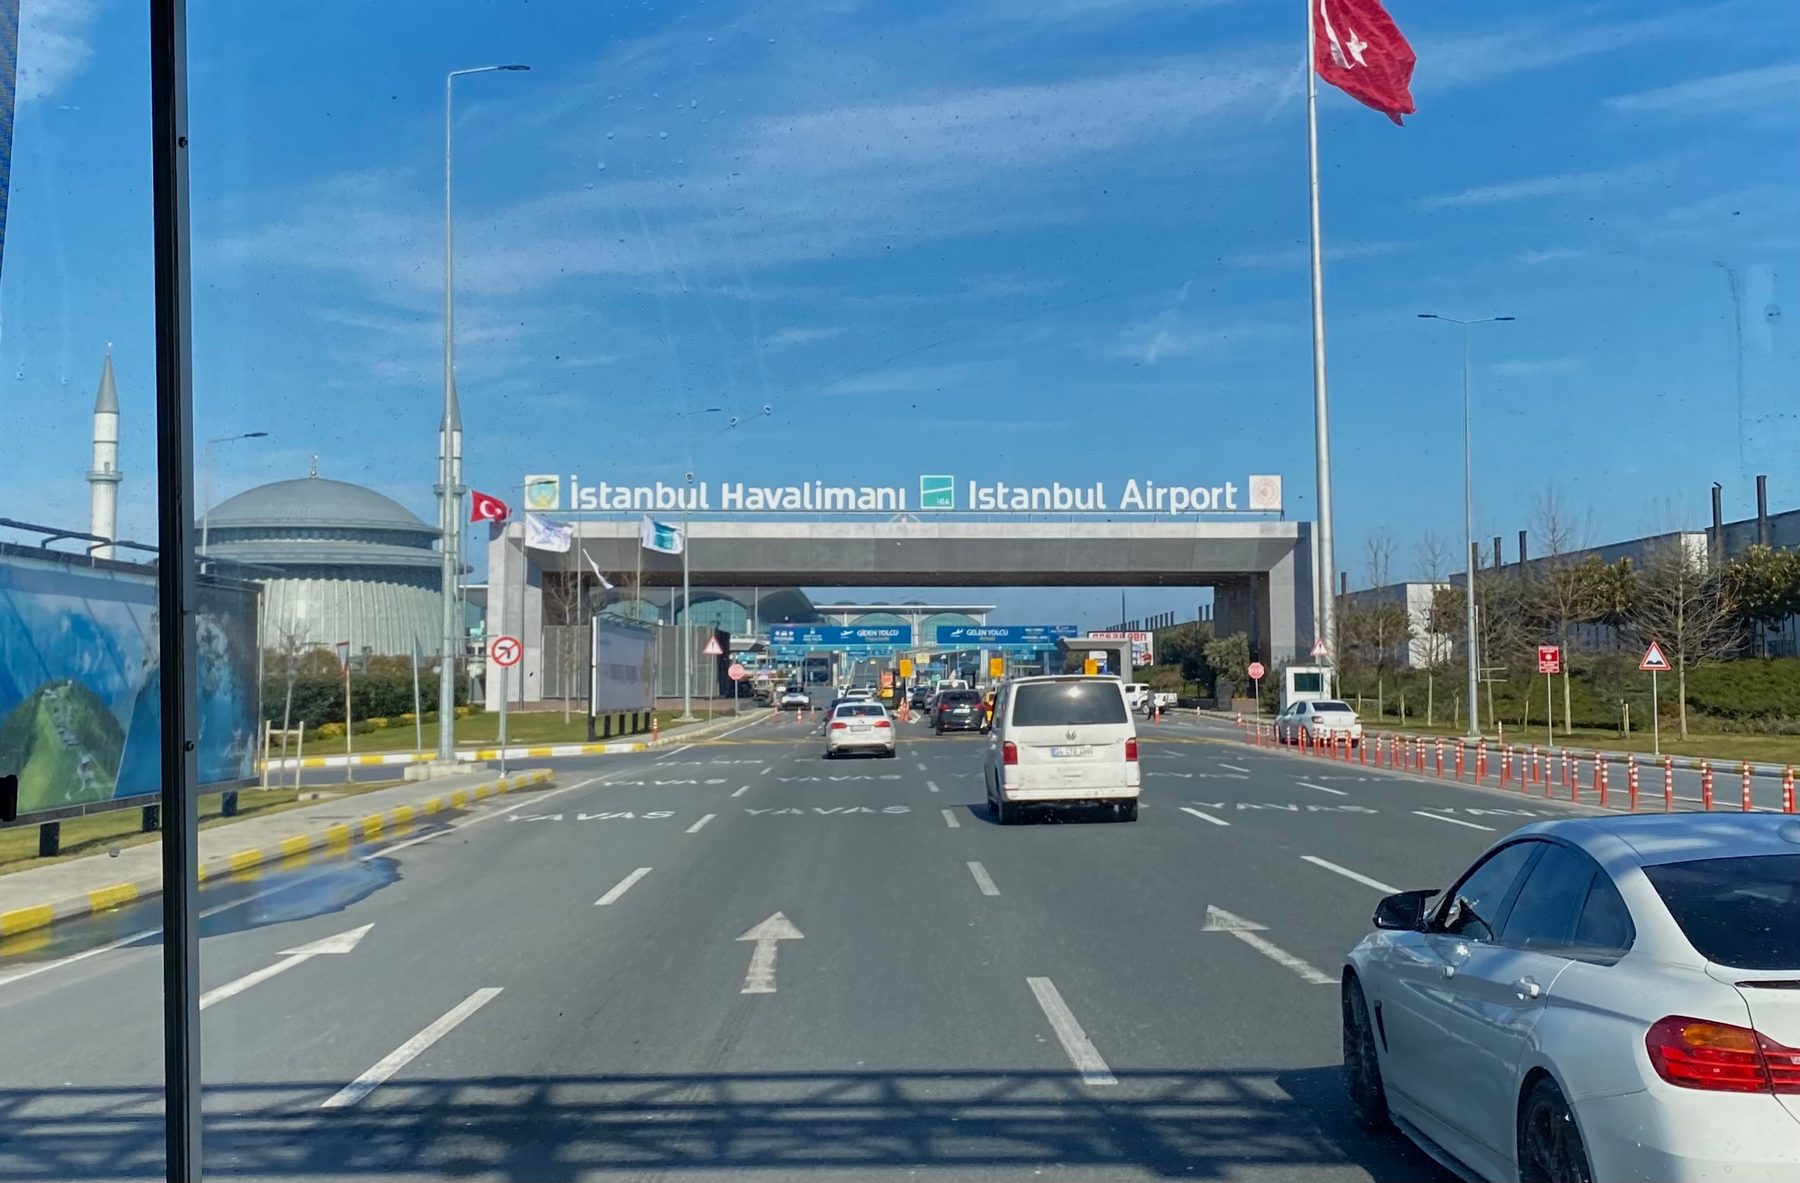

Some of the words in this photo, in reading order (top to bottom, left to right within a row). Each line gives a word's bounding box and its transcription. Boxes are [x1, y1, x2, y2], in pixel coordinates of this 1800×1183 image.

[571, 474, 710, 509] İstanbul
[721, 480, 906, 510] Havalimanı
[969, 480, 1107, 510] Istanbul
[1119, 478, 1239, 515] Airport
